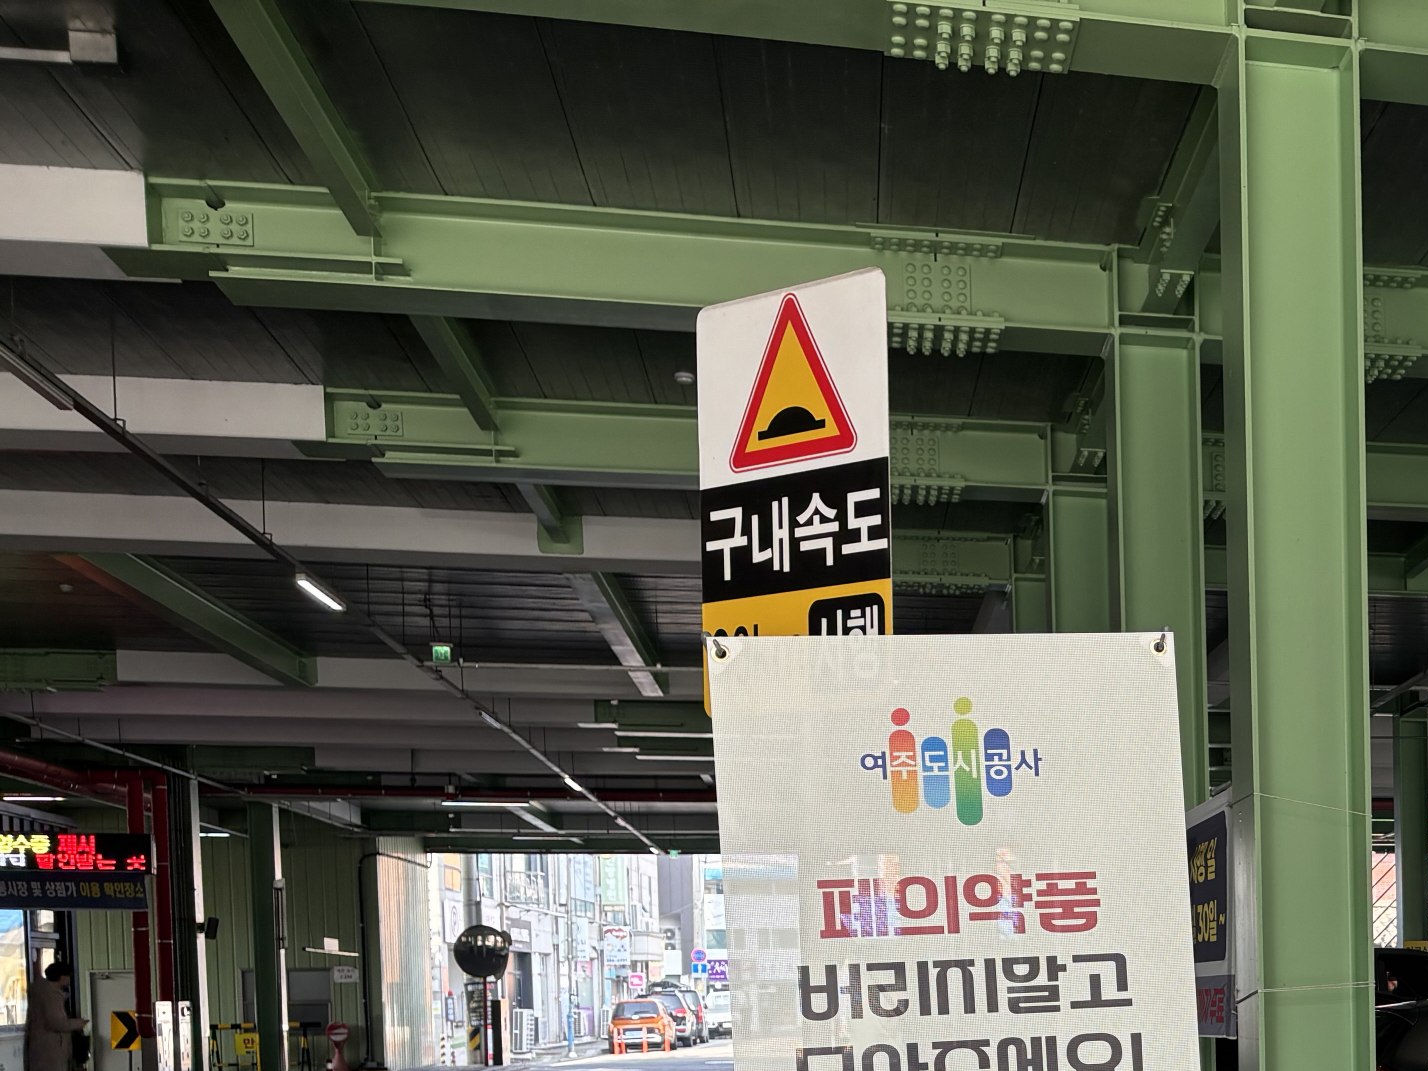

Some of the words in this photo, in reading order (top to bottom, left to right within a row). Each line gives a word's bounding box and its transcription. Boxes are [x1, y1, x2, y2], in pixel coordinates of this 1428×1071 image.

[705, 487, 888, 581] 구내속도
[860, 748, 1042, 781] 여주도시공사
[30, 881, 42, 897] 및
[45, 881, 77, 897] 상점가
[79, 881, 101, 898] 이용
[103, 881, 144, 898] 확인장소
[816, 871, 1101, 939] 폐의약품
[796, 952, 1133, 1021] 버리지말고
